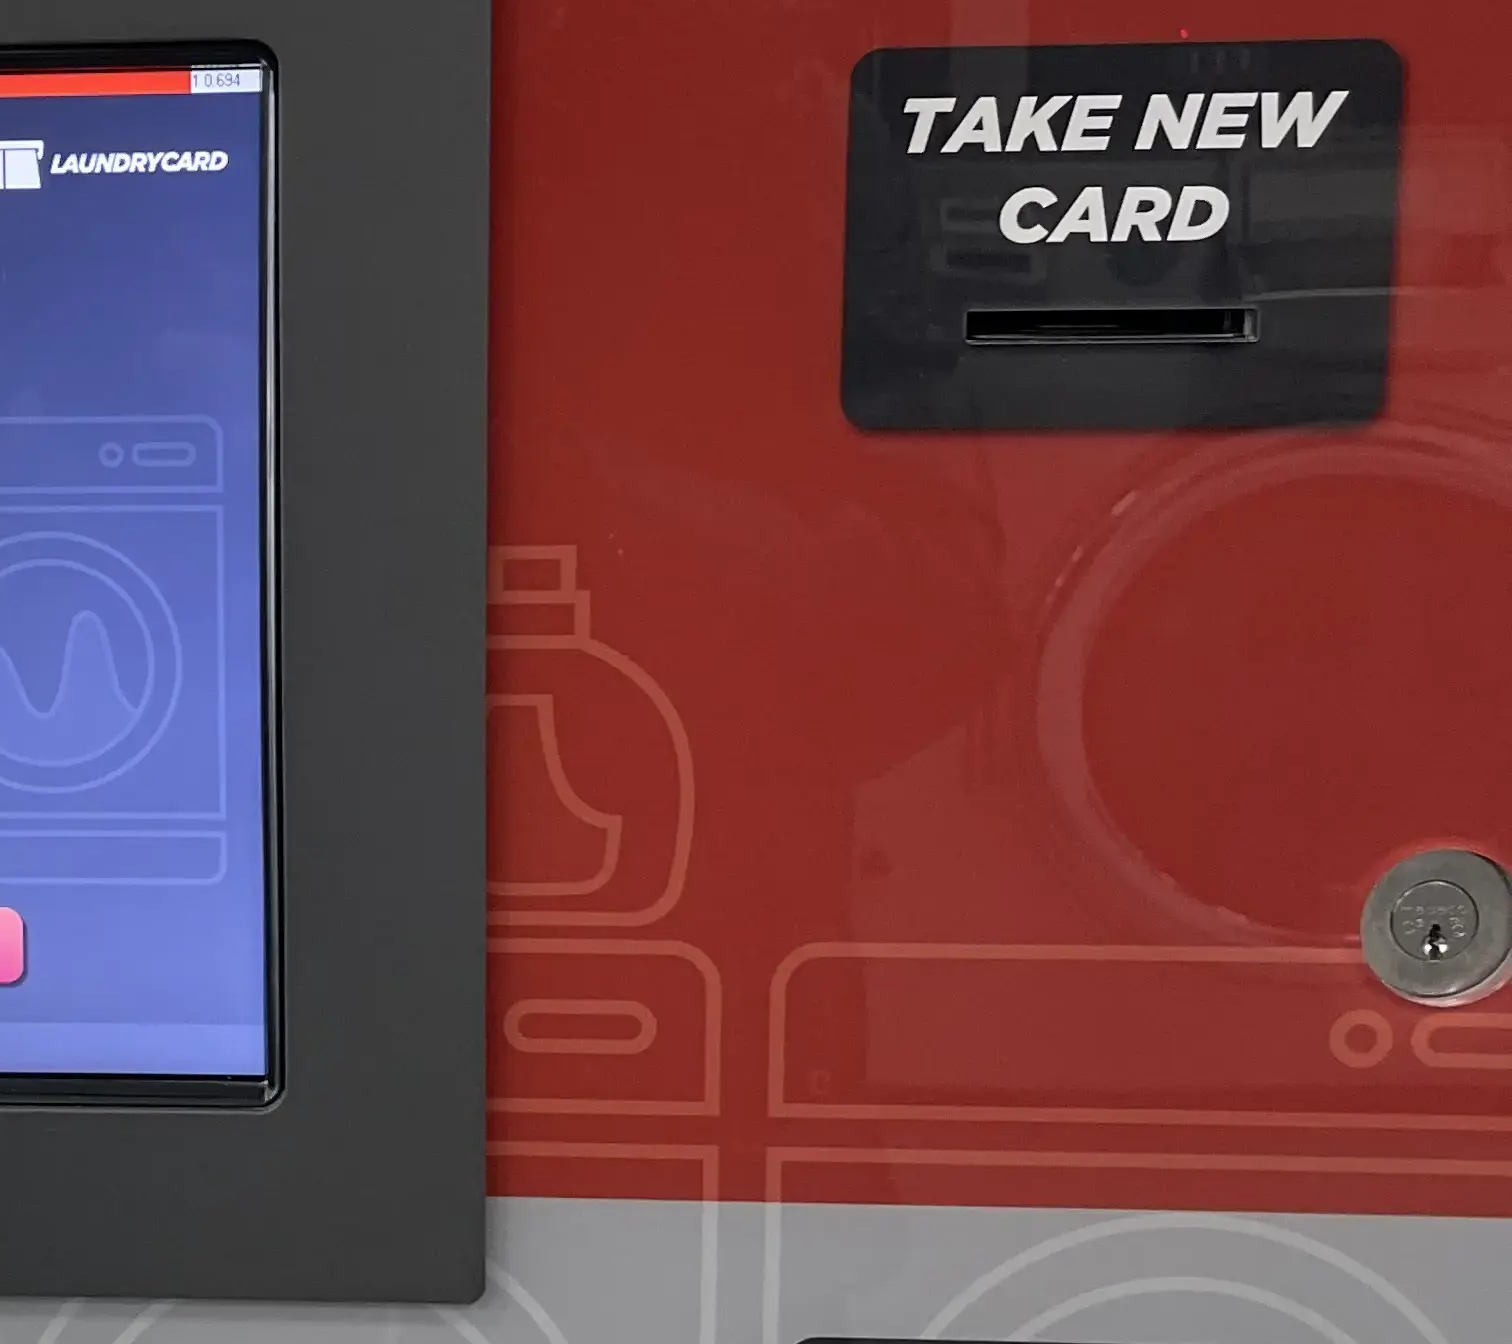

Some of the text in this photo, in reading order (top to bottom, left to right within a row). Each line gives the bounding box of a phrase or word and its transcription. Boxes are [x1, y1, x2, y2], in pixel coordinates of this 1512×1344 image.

[901, 90, 1350, 154] TAKE NEW
[50, 150, 229, 174] LAUNDRYCARD
[997, 184, 1230, 244] CARD
